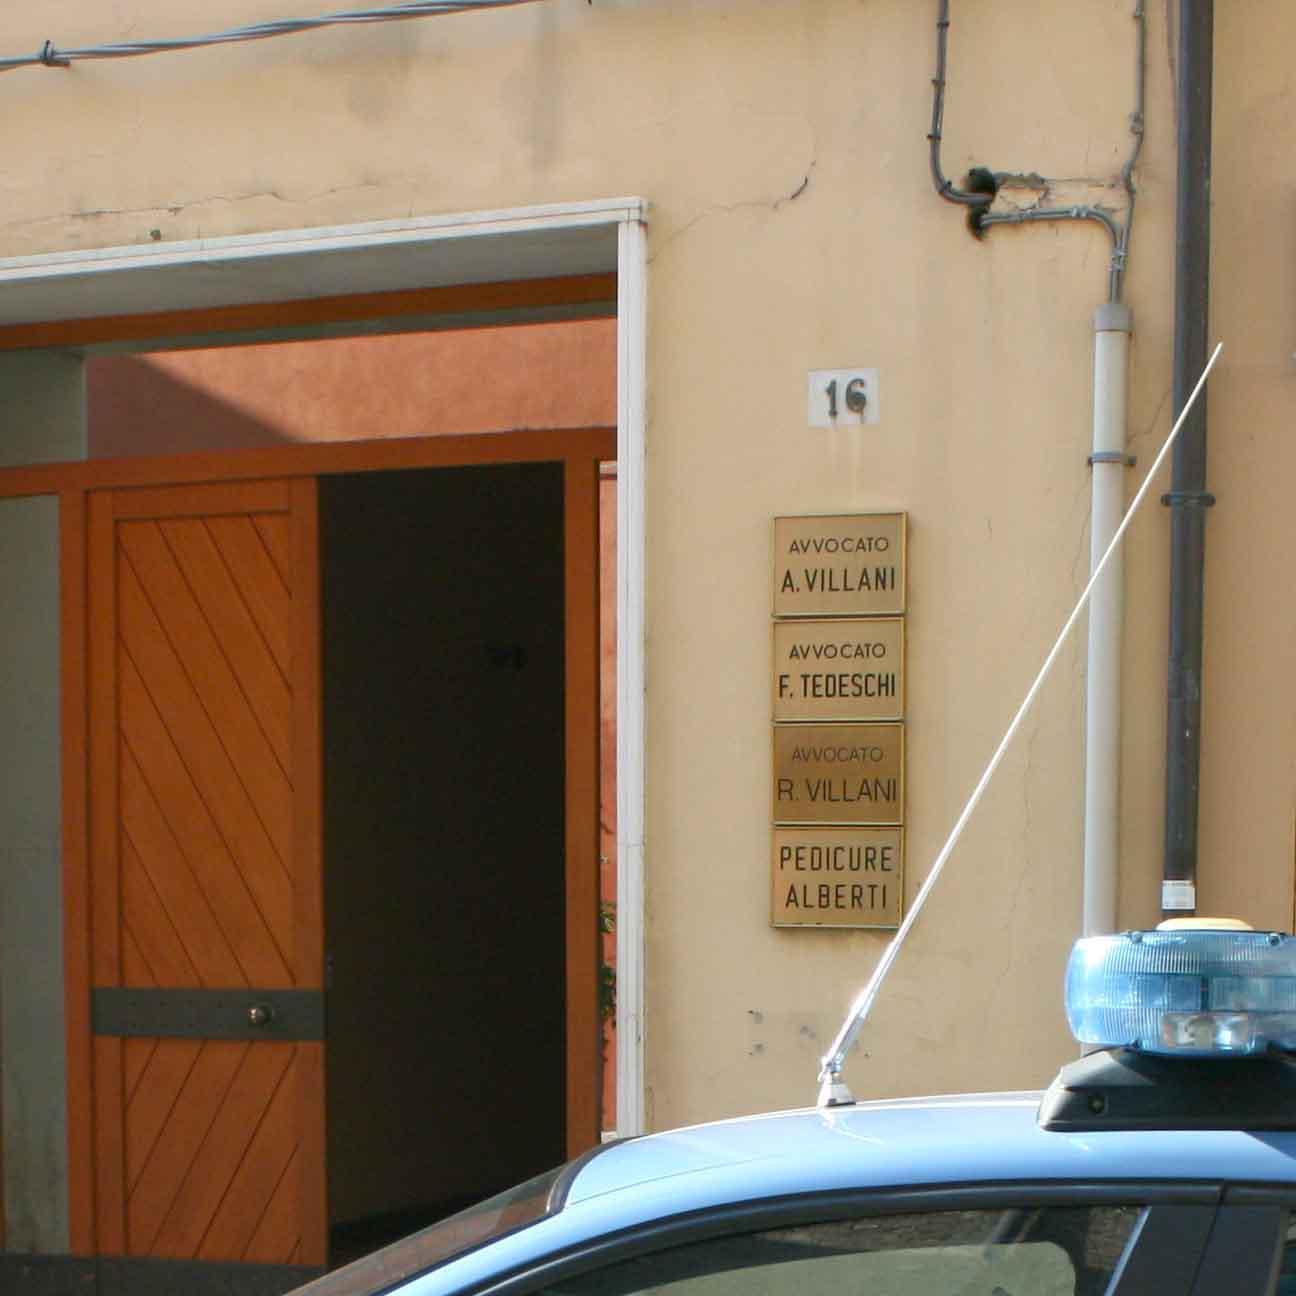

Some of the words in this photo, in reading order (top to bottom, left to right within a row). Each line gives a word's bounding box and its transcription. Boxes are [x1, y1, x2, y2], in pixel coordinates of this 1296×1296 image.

[825, 378, 867, 418] 16
[789, 537, 889, 555] AVVOCATO
[789, 643, 886, 660] AVVOCATO
[778, 674, 794, 699] F.
[801, 673, 896, 699] TEDESCHI
[791, 747, 884, 763] AVVOCATO
[777, 778, 800, 801] R.
[806, 778, 896, 802] VILLANI
[780, 846, 893, 872] PEDICURE
[785, 884, 887, 910] ALBERTI
